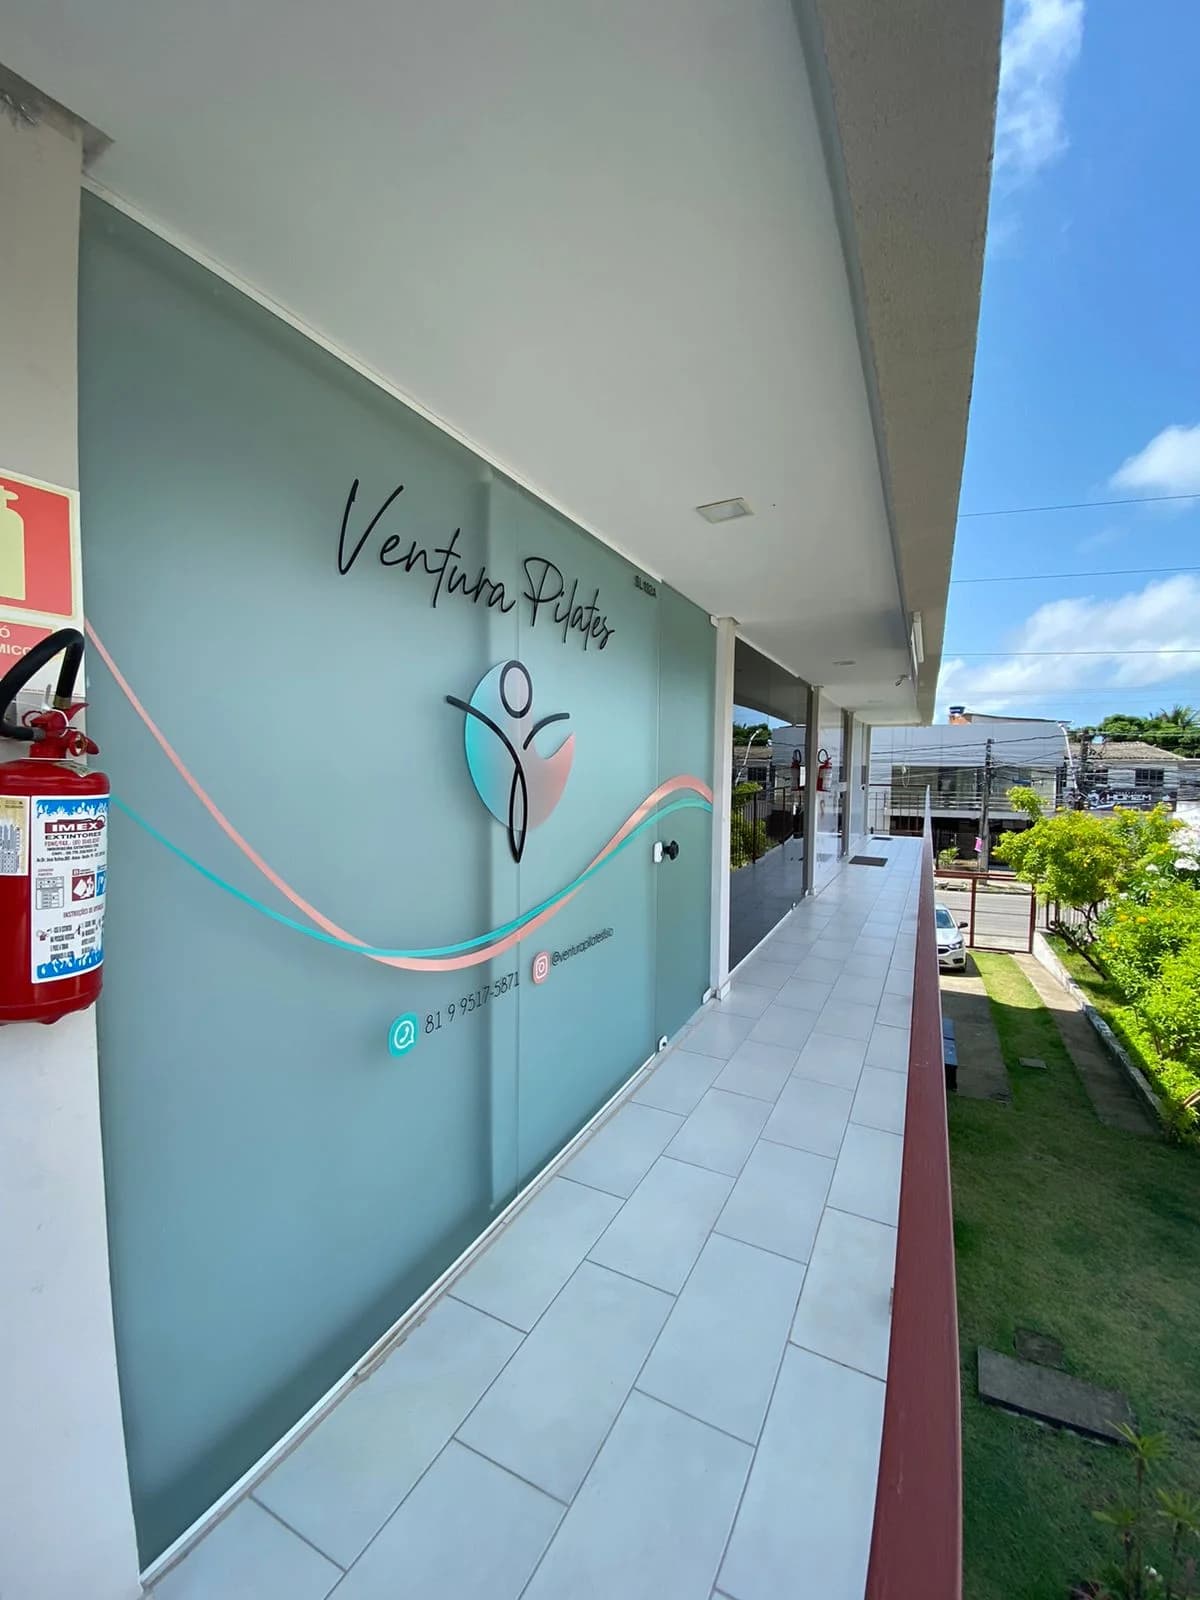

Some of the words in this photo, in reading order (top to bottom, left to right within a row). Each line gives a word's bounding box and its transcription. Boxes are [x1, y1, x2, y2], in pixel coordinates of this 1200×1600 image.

[338, 478, 516, 613] Ventura
[524, 556, 615, 650] Pilates
[45, 831, 102, 840] EXTINTORES
[51, 821, 98, 832] IMEX
[425, 1011, 442, 1034] 81
[447, 1003, 456, 1022] 9
[460, 971, 520, 1015] 9517-5871
